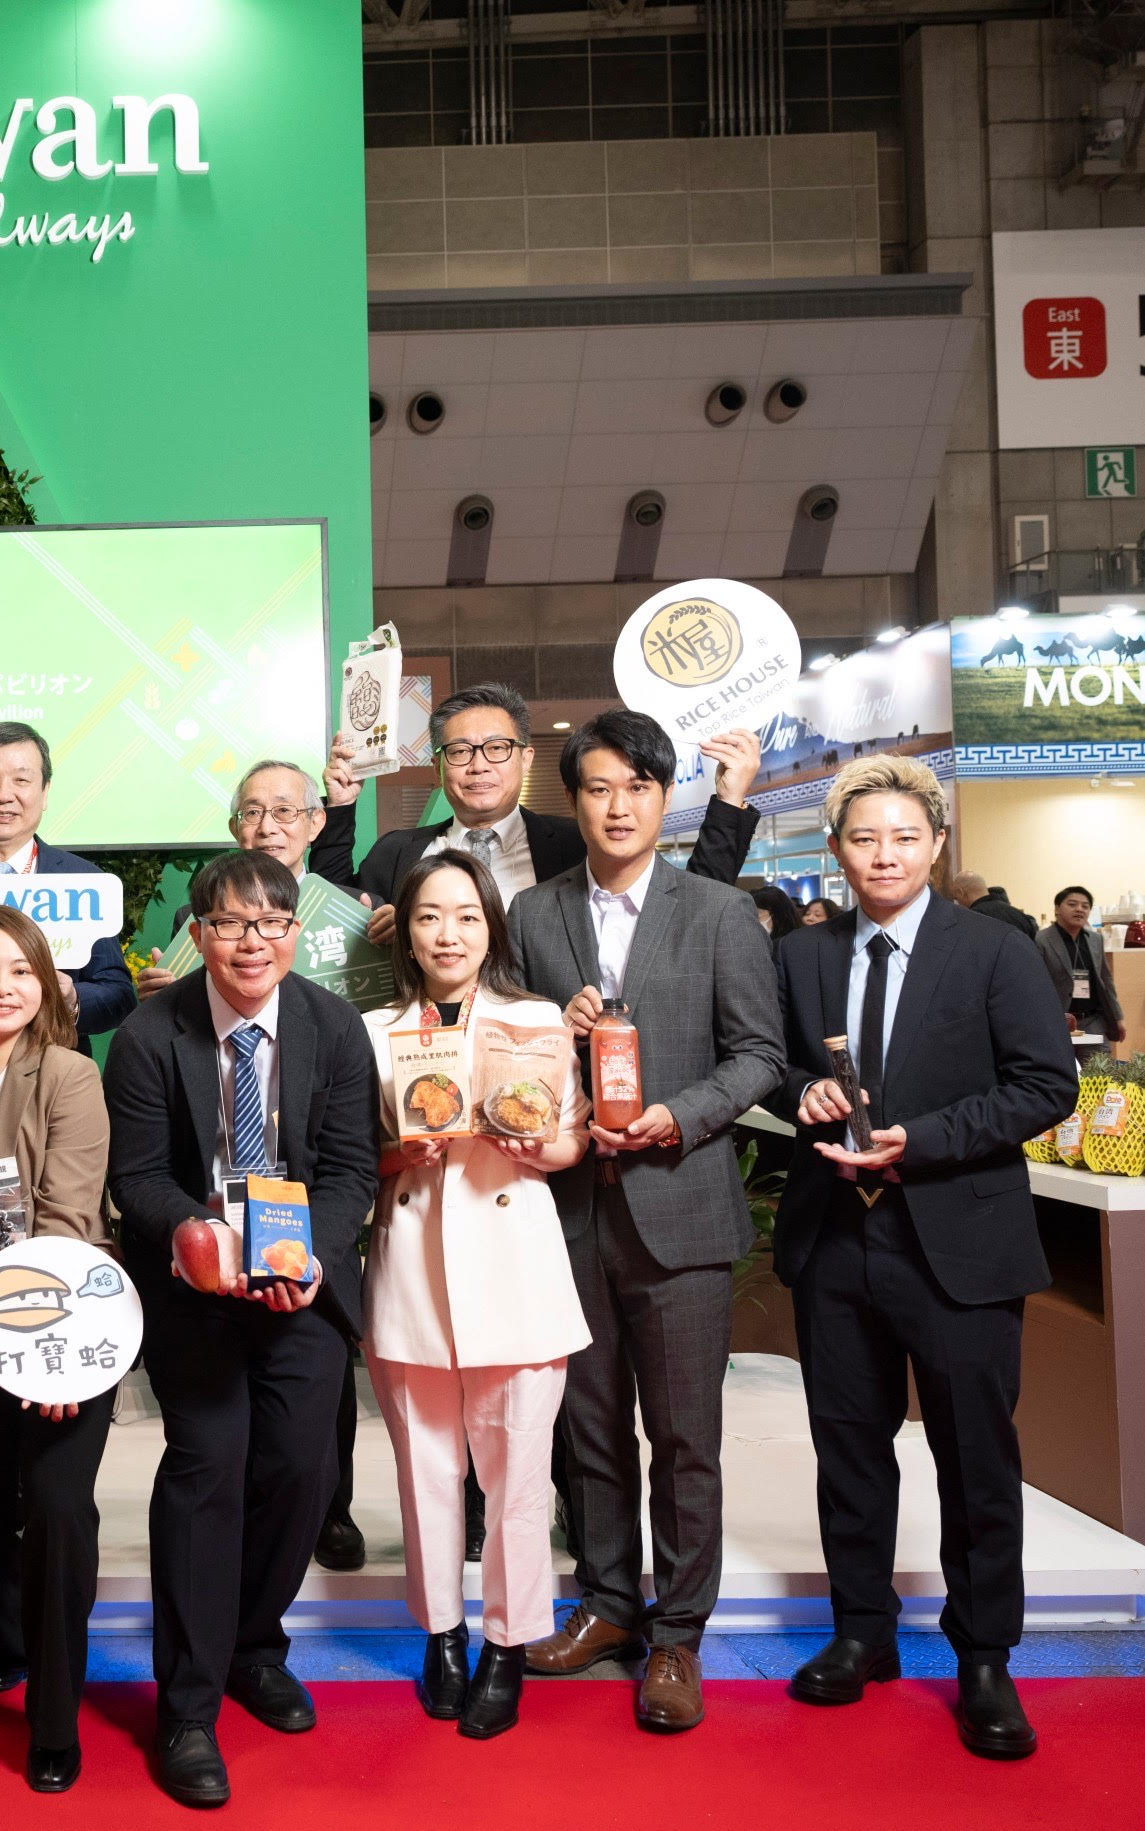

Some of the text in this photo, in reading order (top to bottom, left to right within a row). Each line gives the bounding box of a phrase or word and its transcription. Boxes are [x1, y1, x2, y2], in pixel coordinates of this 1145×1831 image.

[1048, 307, 1081, 323] East
[1047, 327, 1083, 371] 東
[674, 654, 790, 731] RICE HOUSE
[697, 677, 790, 738] Top Rice Taiwan
[265, 1207, 293, 1218] Dried
[258, 1215, 304, 1227] Mangoes
[94, 1272, 112, 1288] 蛤
